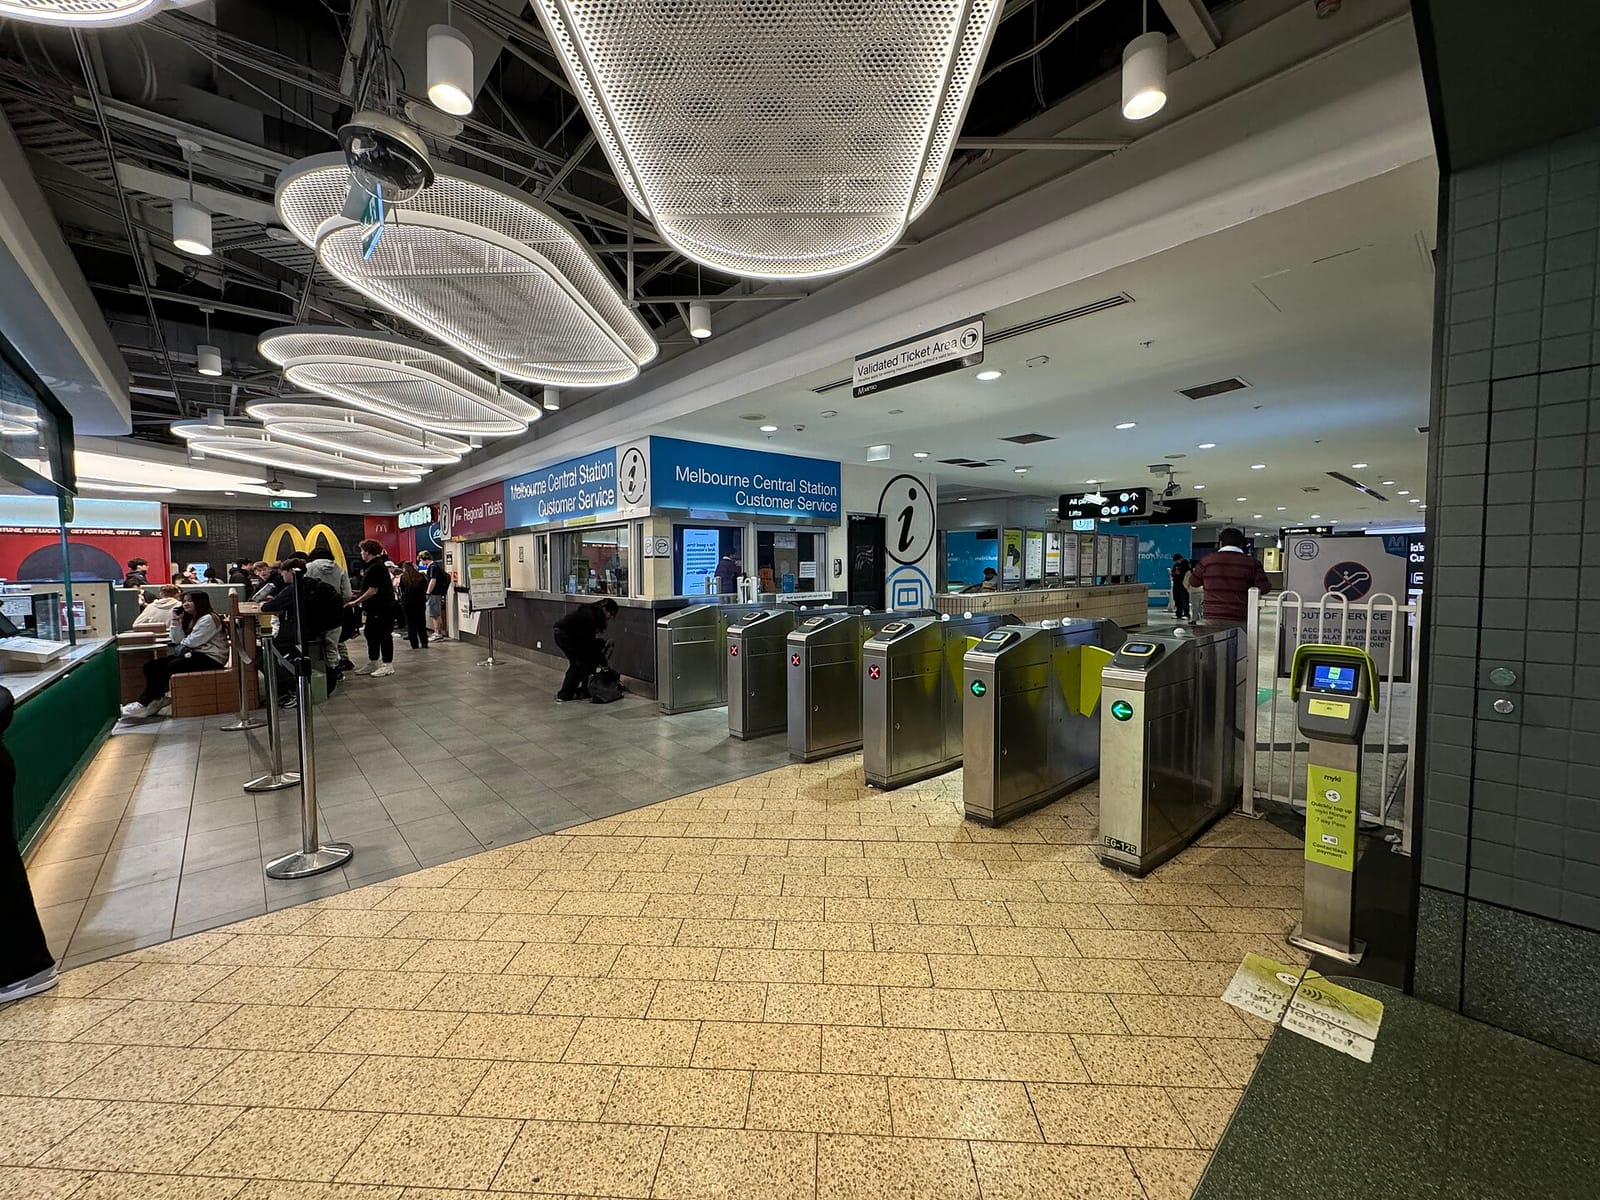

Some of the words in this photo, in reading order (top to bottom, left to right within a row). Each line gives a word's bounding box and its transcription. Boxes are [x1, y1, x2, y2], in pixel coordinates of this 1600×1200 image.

[857, 355, 898, 376] Validated
[901, 346, 930, 364] Ticket
[933, 338, 957, 354] Area
[510, 482, 546, 502] Melbourne
[548, 468, 577, 493] Central
[579, 460, 614, 485] Station
[675, 465, 749, 488] Melbourne
[753, 474, 796, 493] Central
[799, 479, 837, 497] Station
[463, 504, 484, 524] Regional
[484, 501, 503, 516] Tickets
[538, 497, 575, 517] Customer
[578, 486, 615, 511] Service
[735, 491, 794, 510] Customer
[797, 495, 837, 513] Service
[1324, 612, 1338, 620] OF
[1341, 612, 1387, 621] ERVCE
[1324, 775, 1341, 783] myki
[1105, 836, 1136, 854] EG-125
[1244, 998, 1273, 1015] day
[1311, 1009, 1351, 1027] your
